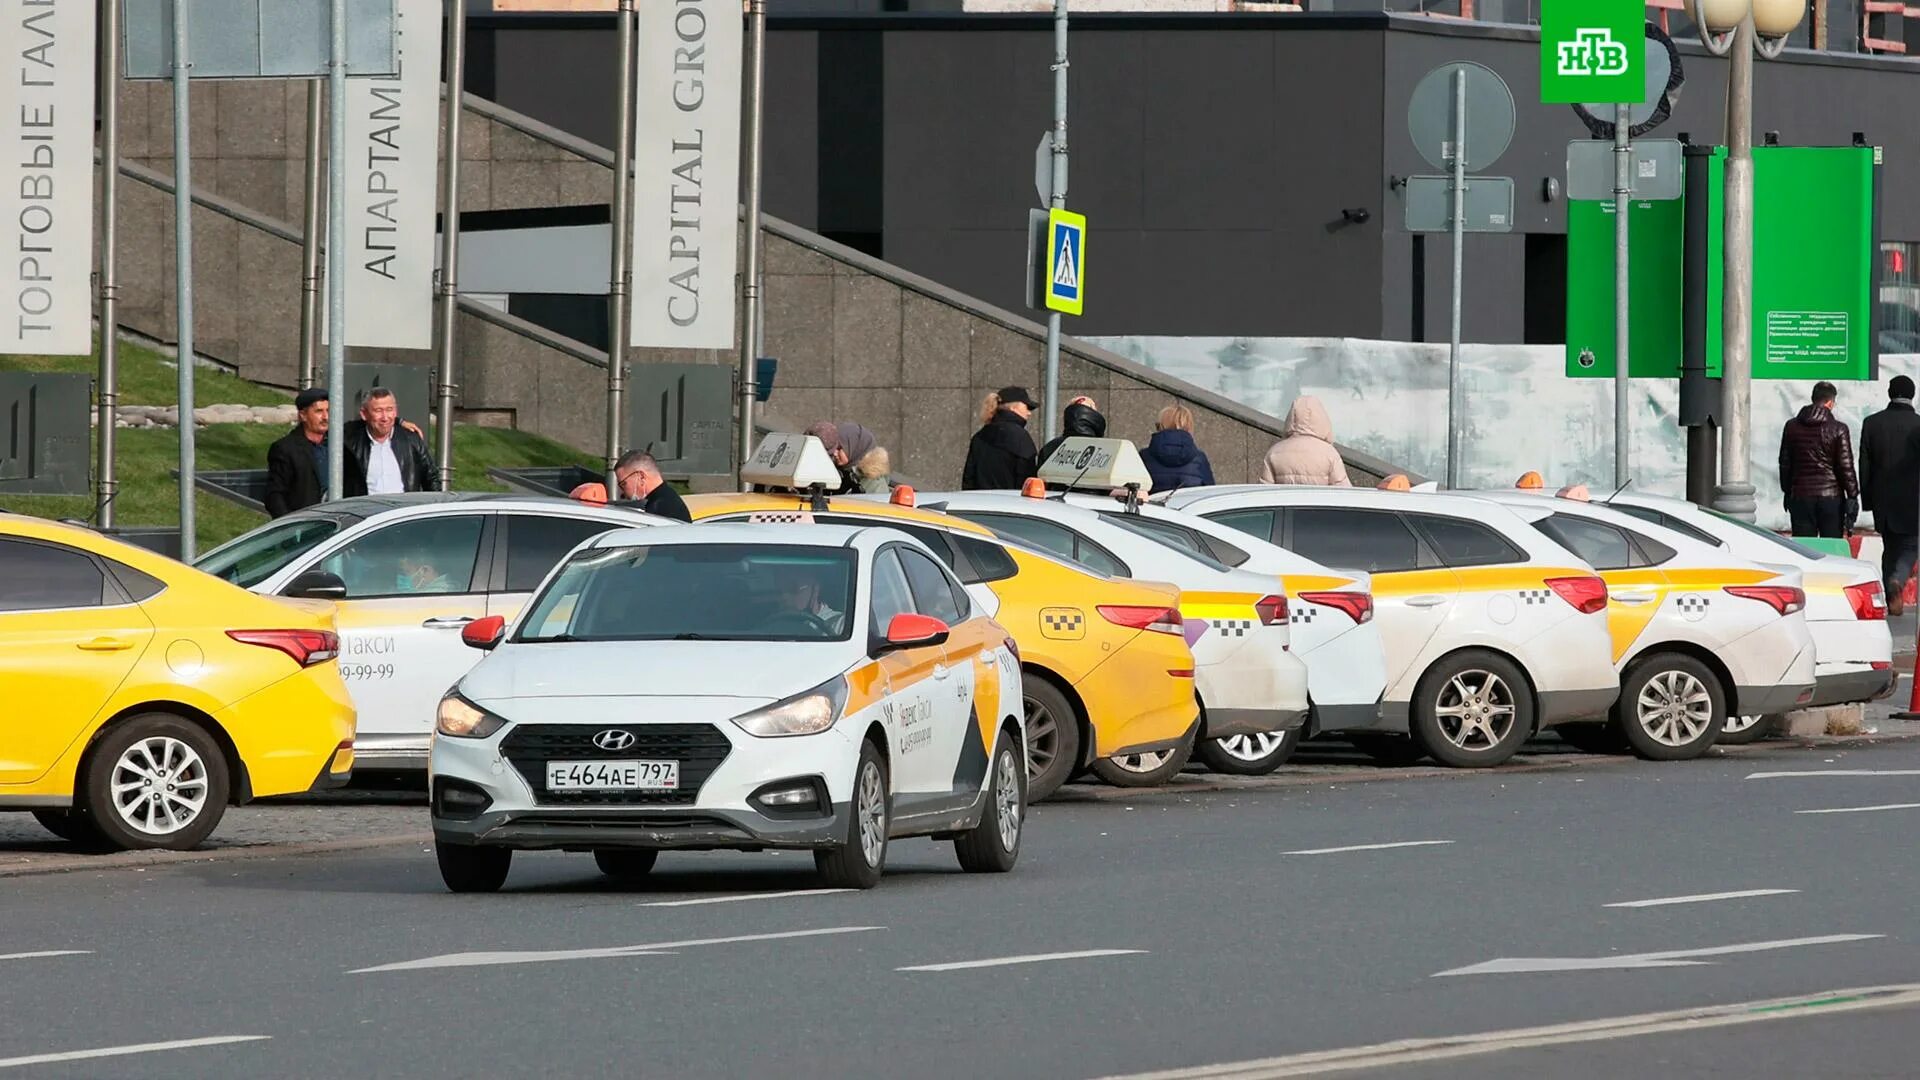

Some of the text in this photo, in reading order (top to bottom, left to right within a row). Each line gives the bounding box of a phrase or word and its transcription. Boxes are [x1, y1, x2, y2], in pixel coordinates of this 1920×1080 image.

[18, 104, 55, 340] ТОРГОВЫЕ
[667, 0, 708, 327] CAPITAL GRO
[640, 763, 672, 780] 797
